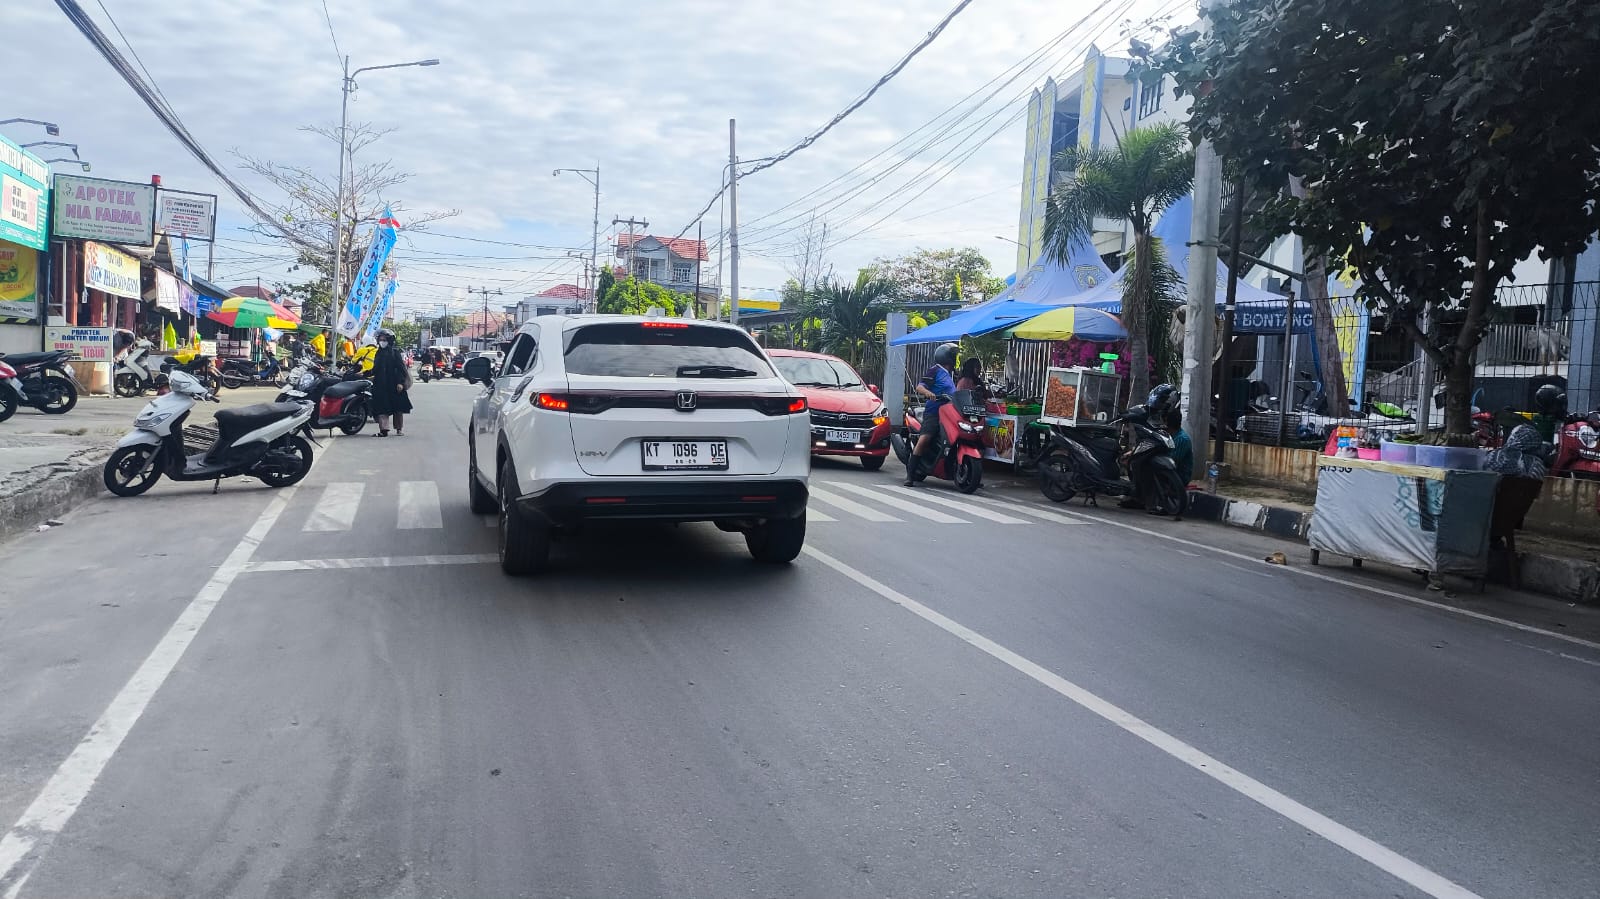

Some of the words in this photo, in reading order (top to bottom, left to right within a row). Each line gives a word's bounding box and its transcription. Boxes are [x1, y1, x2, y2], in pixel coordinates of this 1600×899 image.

[75, 185, 136, 206] APOTEK
[65, 203, 92, 220] NIA
[95, 207, 143, 226] FARMA
[84, 348, 104, 358] LIBUR
[646, 443, 660, 457] KT
[672, 443, 698, 457] 1096
